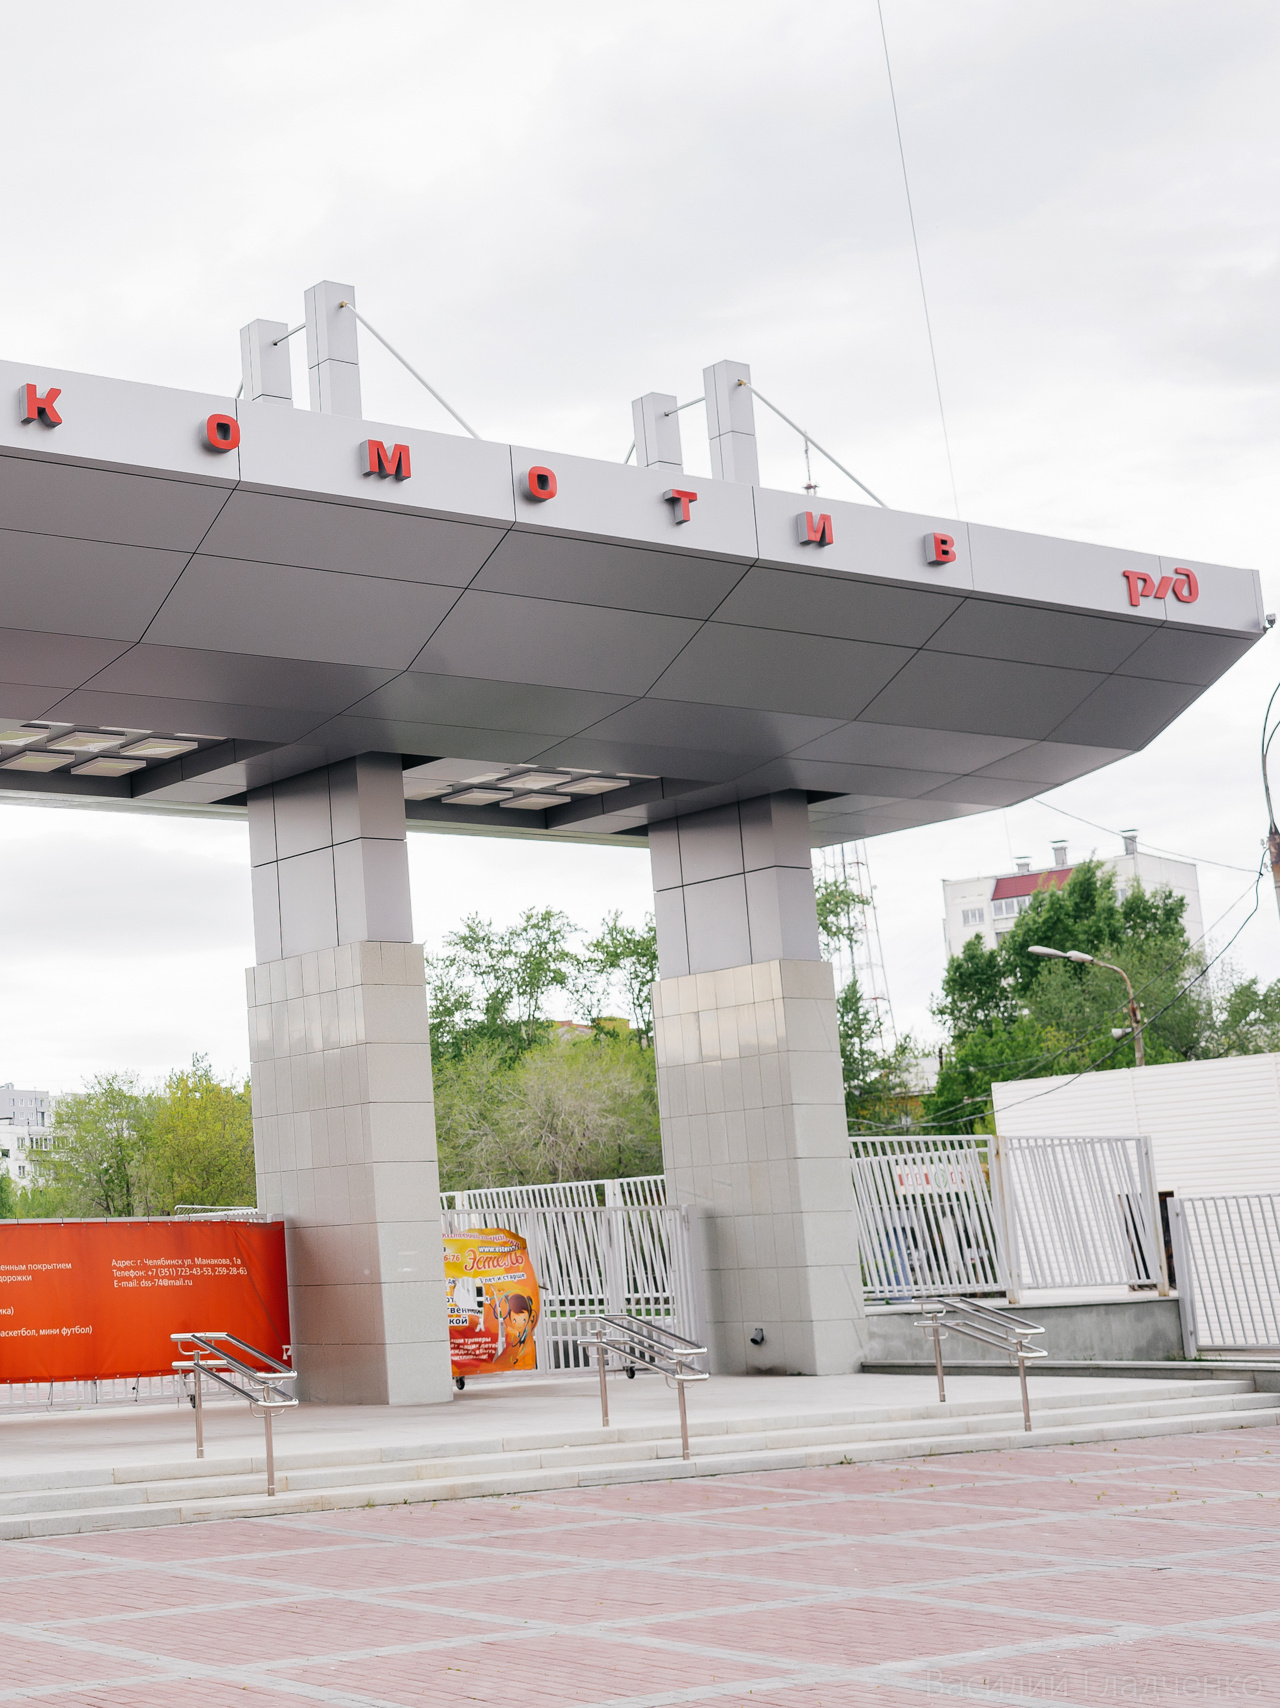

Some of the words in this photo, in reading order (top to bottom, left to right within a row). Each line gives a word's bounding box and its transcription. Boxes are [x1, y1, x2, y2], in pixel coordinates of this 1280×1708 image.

[28, 1263, 72, 1271] покрытием
[112, 1259, 136, 1268] Адрес:
[144, 1258, 182, 1266] Челябинск
[233, 1257, 241, 1265] 1а
[112, 1269, 146, 1278] Телефон:
[158, 1268, 176, 1277] (351)
[177, 1267, 214, 1276] 723-43-53,
[215, 1267, 248, 1275] 259-28-63
[114, 1279, 139, 1288] E-mail:
[140, 1278, 193, 1287] dss-74@mail.ru
[61, 1325, 92, 1337] футбол)
